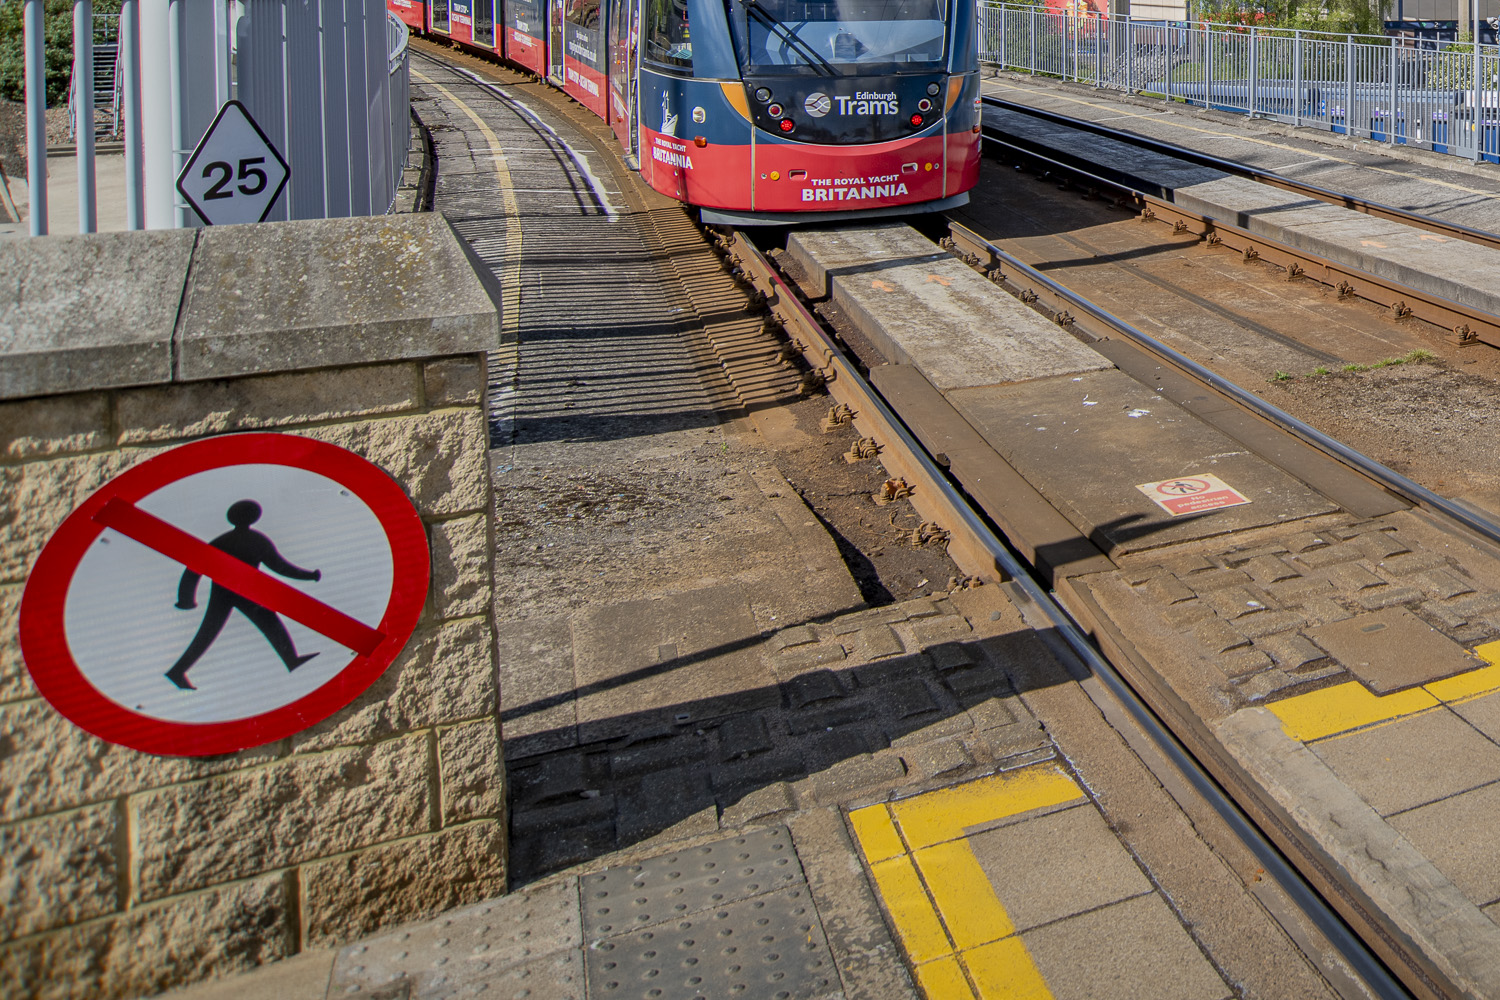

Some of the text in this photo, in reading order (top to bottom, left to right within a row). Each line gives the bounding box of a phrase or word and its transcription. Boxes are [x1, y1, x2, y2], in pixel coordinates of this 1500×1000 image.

[856, 91, 897, 101] Edinburgh
[834, 95, 899, 116] Trams
[652, 146, 693, 170] BRITANNIA
[201, 156, 268, 201] 25
[811, 174, 900, 186] THE ROYAL YACHT
[802, 183, 909, 202] BRITANNIA
[1177, 495, 1229, 508] pedestrian
[1190, 500, 1226, 510] access
